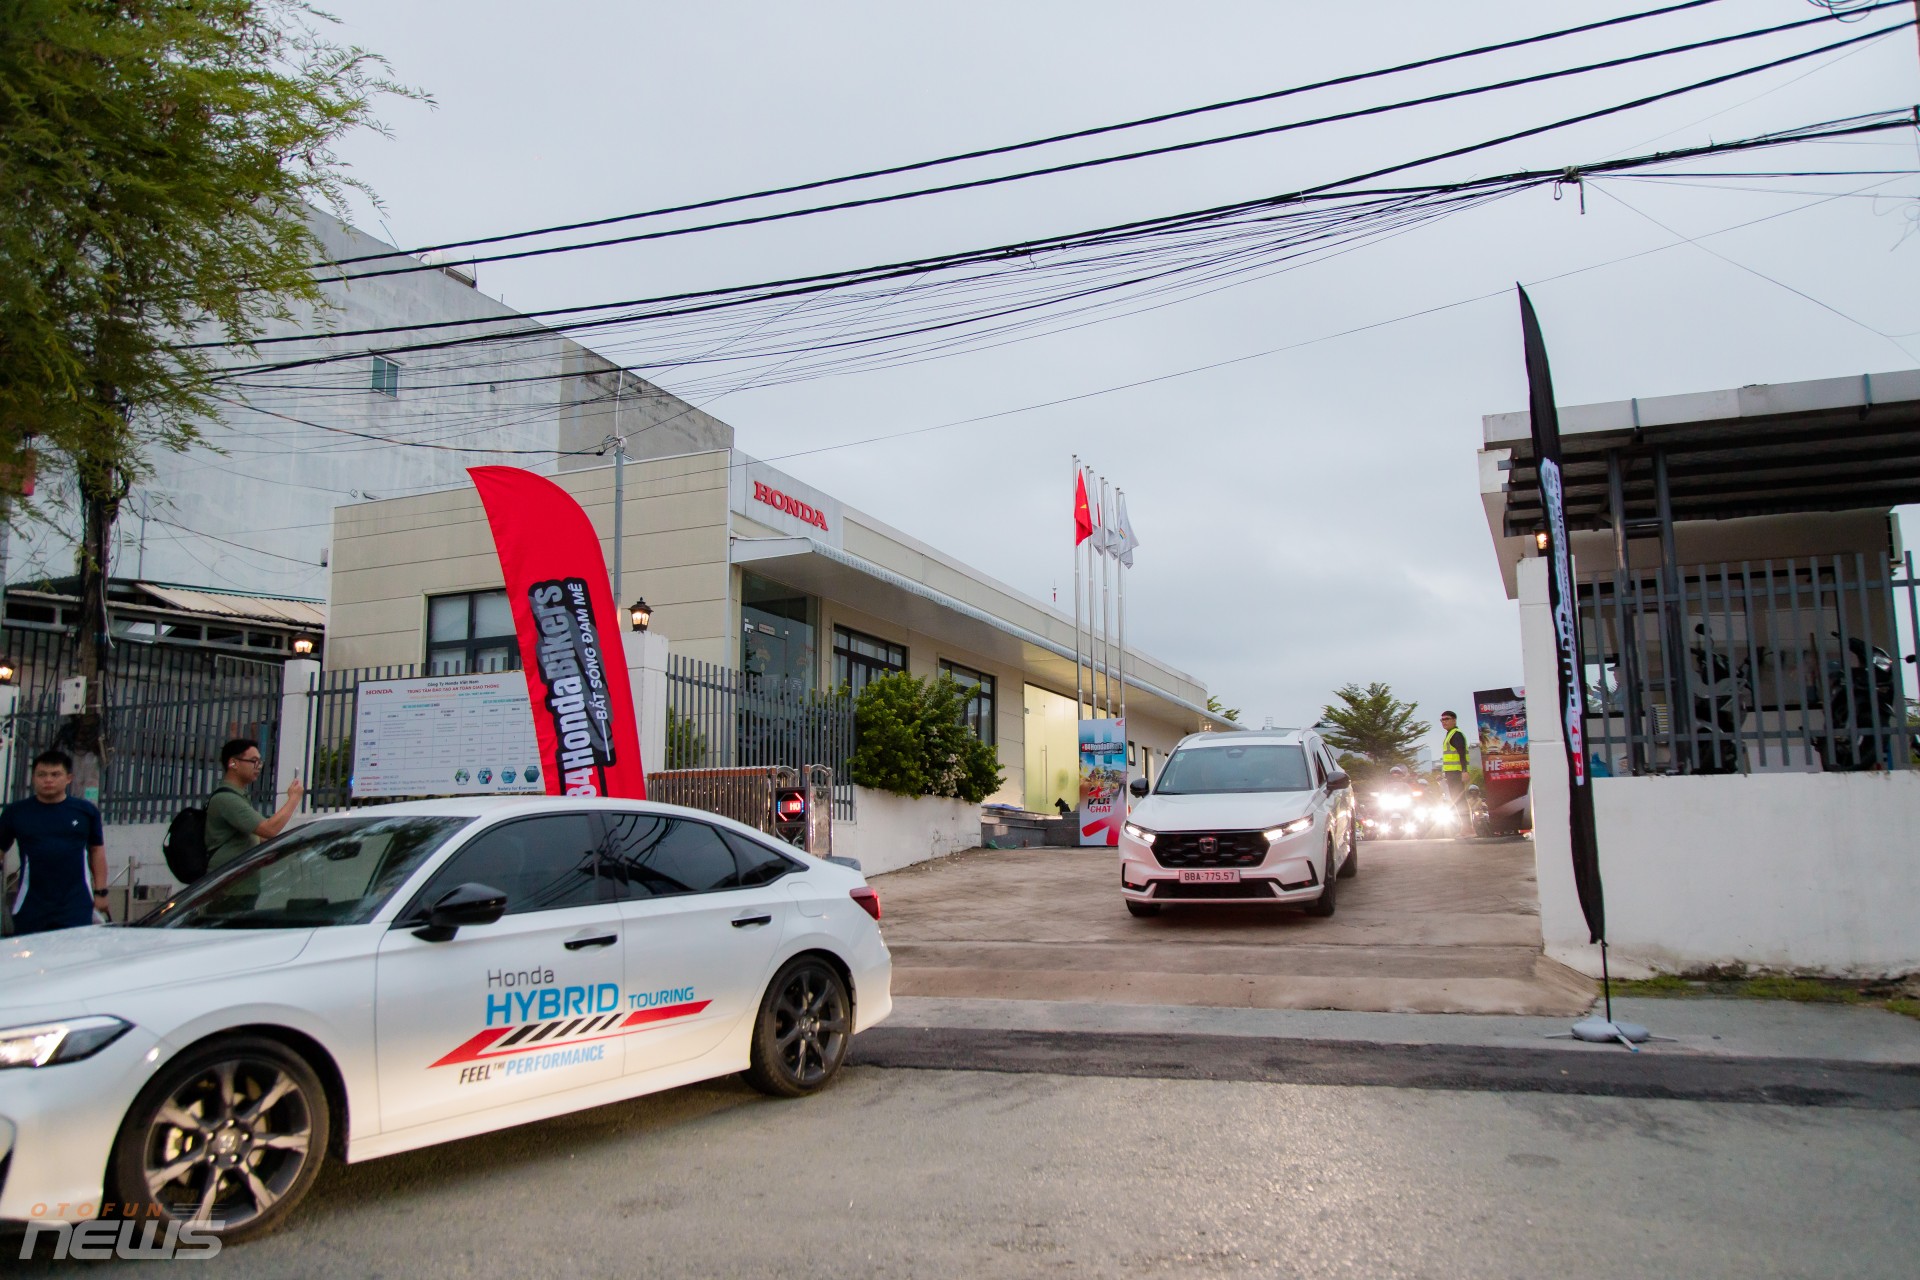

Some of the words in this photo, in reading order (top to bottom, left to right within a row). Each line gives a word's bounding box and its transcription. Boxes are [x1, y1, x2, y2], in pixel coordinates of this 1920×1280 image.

[754, 480, 829, 532] HONDA
[567, 582, 586, 606] MÊ
[576, 608, 595, 643] ĐAM
[584, 647, 603, 689] SÓNG
[589, 691, 608, 720] BẮT
[1184, 872, 1235, 881] 88A-775.57
[488, 965, 555, 988] Honda
[486, 983, 619, 1026] HYBRID
[628, 986, 695, 1009] TOURING
[459, 1065, 492, 1085] FEEL
[505, 1044, 605, 1076] PERFORMANCE
